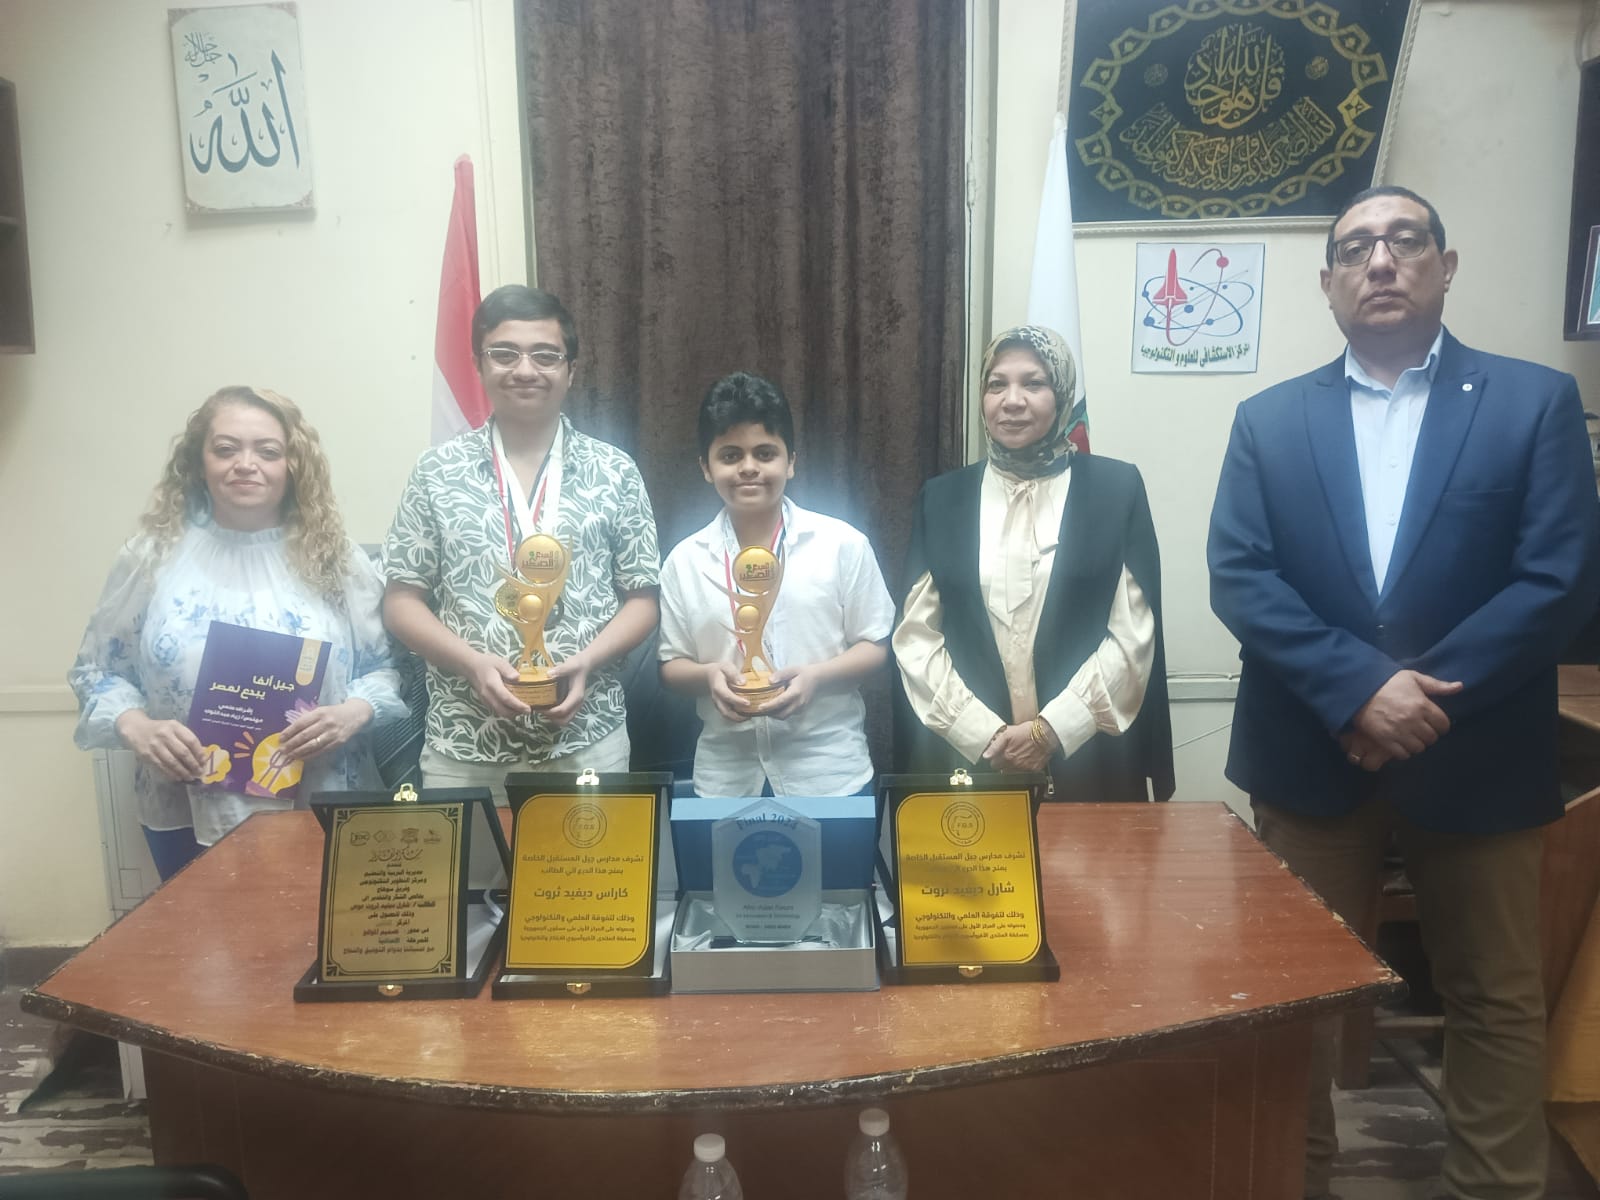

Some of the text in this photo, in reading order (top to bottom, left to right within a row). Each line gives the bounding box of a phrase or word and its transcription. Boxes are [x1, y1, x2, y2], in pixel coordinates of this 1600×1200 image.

[208, 681, 266, 700] يبدع لمصر
[252, 674, 295, 692] جيل ألفا
[736, 812, 766, 829] Final
[546, 854, 580, 863] المستقبل
[533, 885, 629, 901] كاراس ديفيد ثروت
[987, 881, 1015, 897] شارل
